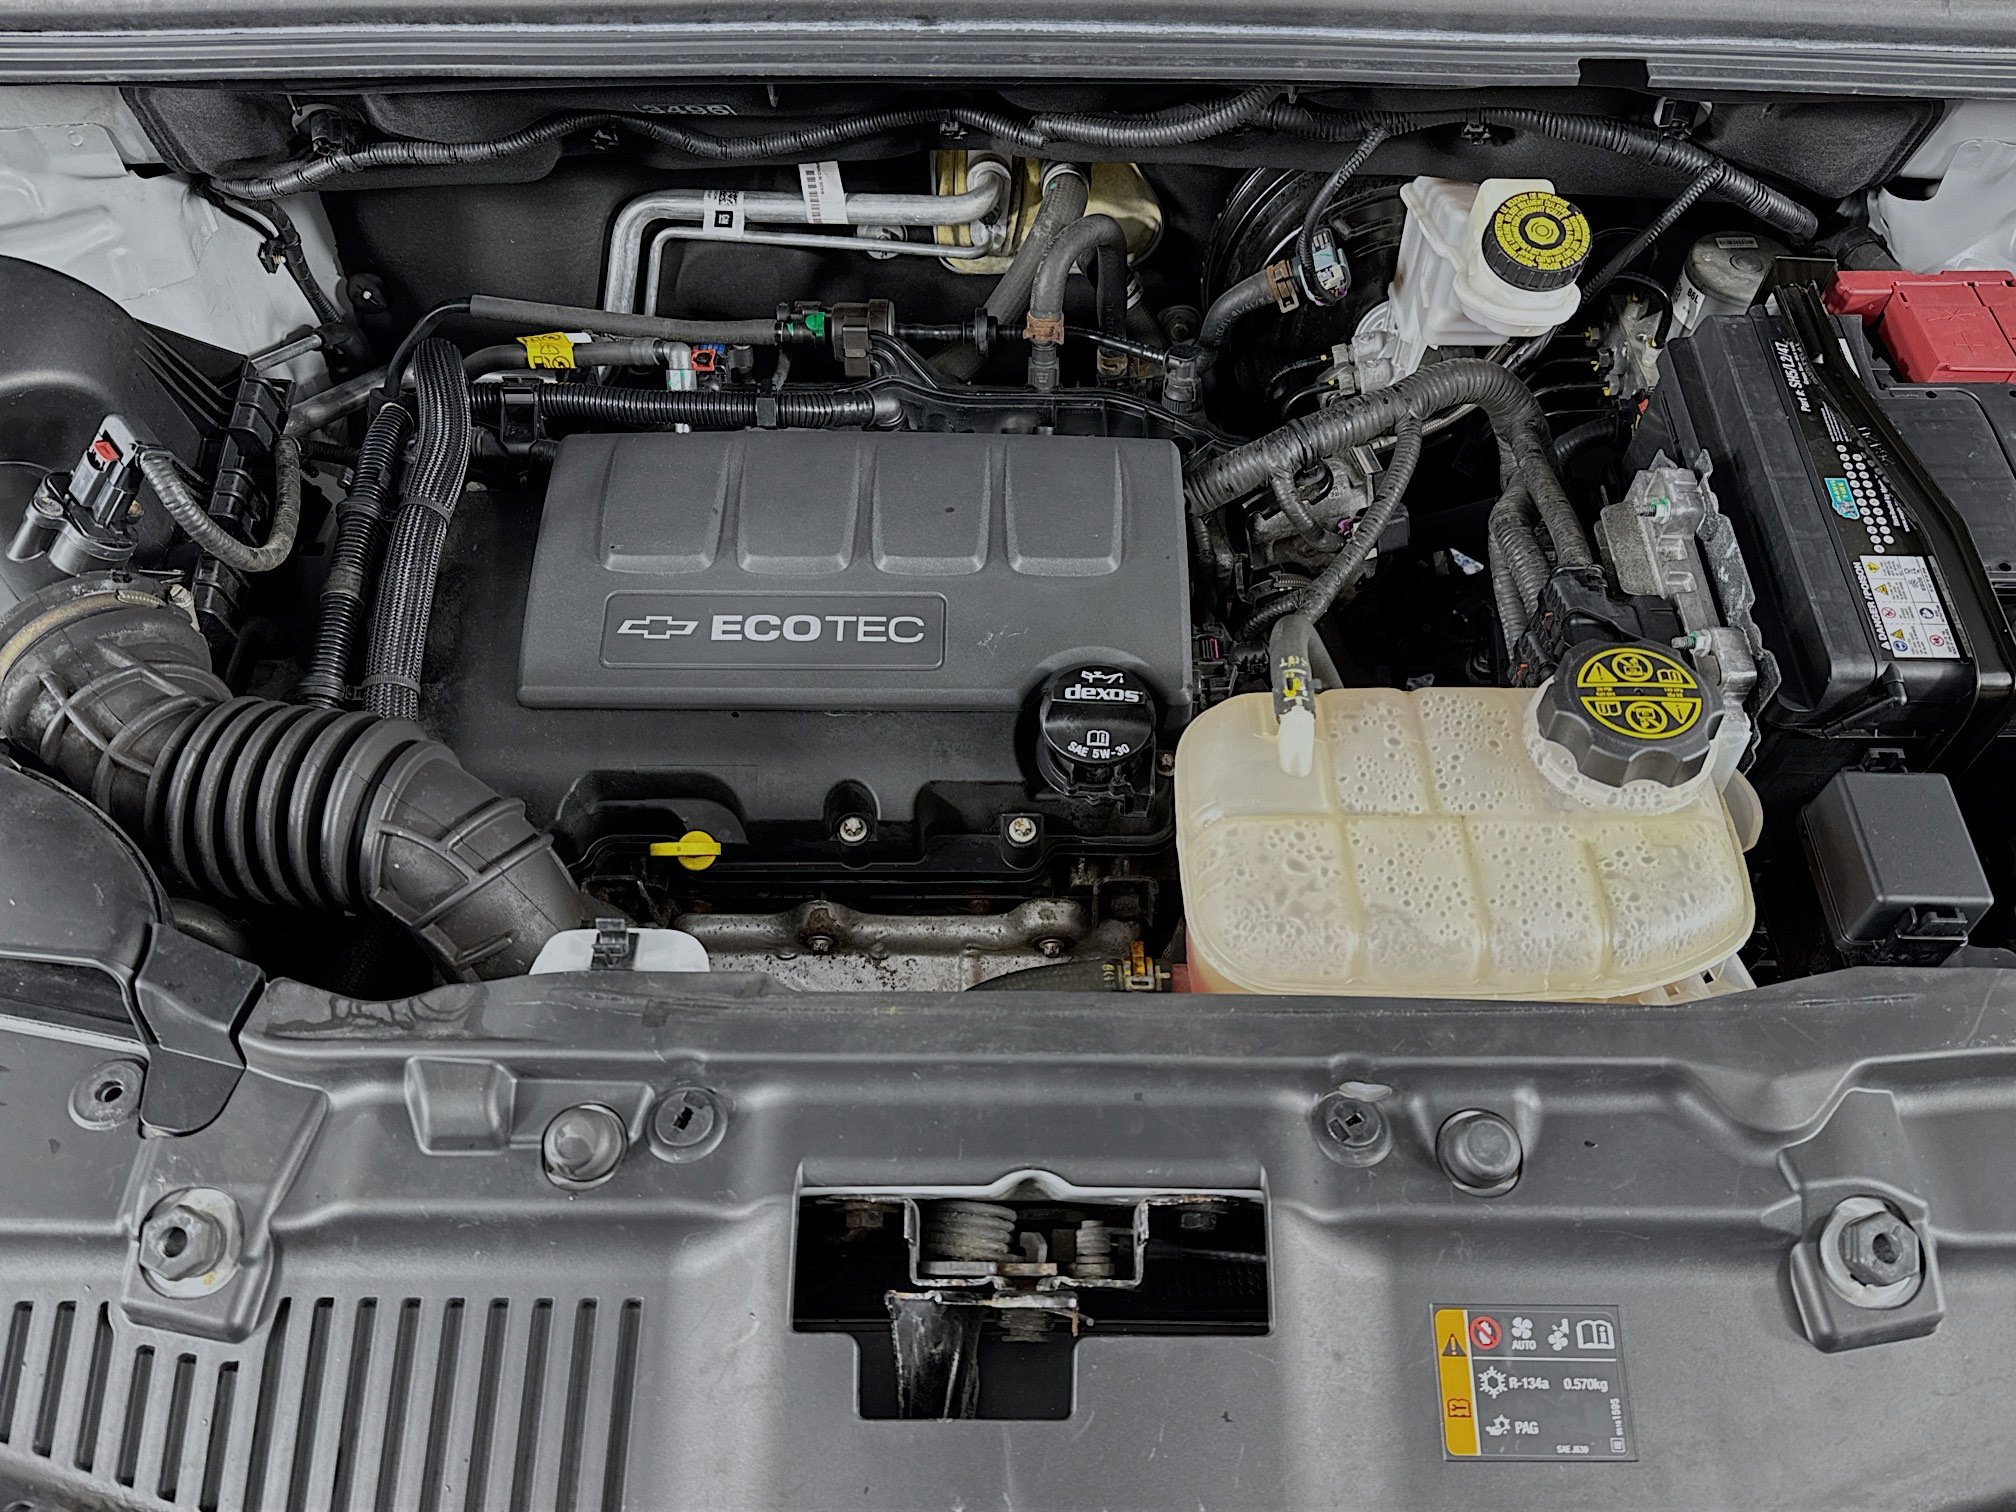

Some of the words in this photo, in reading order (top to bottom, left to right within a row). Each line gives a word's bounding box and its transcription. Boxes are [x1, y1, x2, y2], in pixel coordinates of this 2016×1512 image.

[711, 614, 925, 643] ECOTEC
[1867, 601, 1887, 641] DANGER
[1064, 684, 1140, 703] dexos
[1067, 741, 1090, 758] SAE
[1092, 743, 1131, 760] 5W-30
[1512, 1340, 1537, 1351] AUTO
[1508, 1376, 1550, 1389] R-134a
[1563, 1377, 1609, 1393] 0.570kg
[1514, 1421, 1539, 1435] PAG
